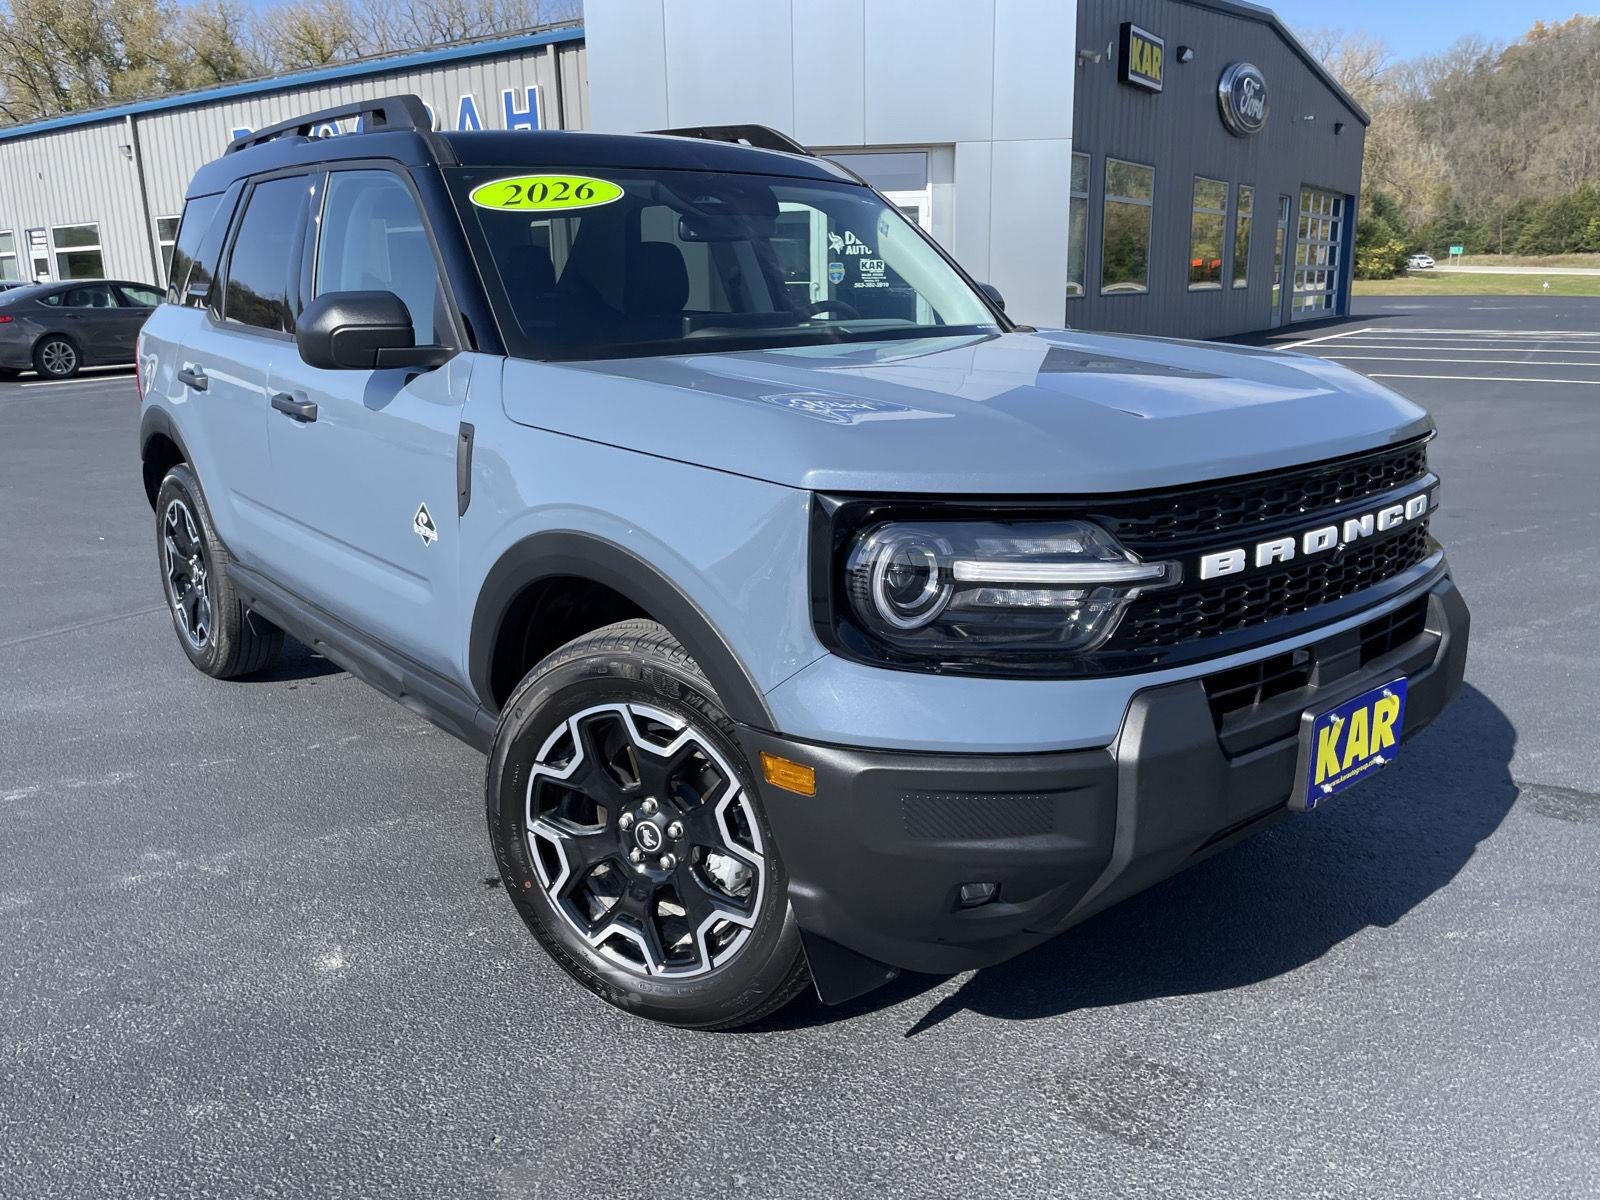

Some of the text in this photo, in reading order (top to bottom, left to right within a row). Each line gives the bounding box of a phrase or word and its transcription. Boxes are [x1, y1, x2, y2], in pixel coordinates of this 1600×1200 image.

[1131, 36, 1162, 80] KAR
[1239, 77, 1265, 119] Ford
[502, 178, 595, 207] 2026
[860, 260, 884, 270] KAR
[1199, 494, 1428, 580] BRONCO
[1314, 693, 1400, 786] KAR
